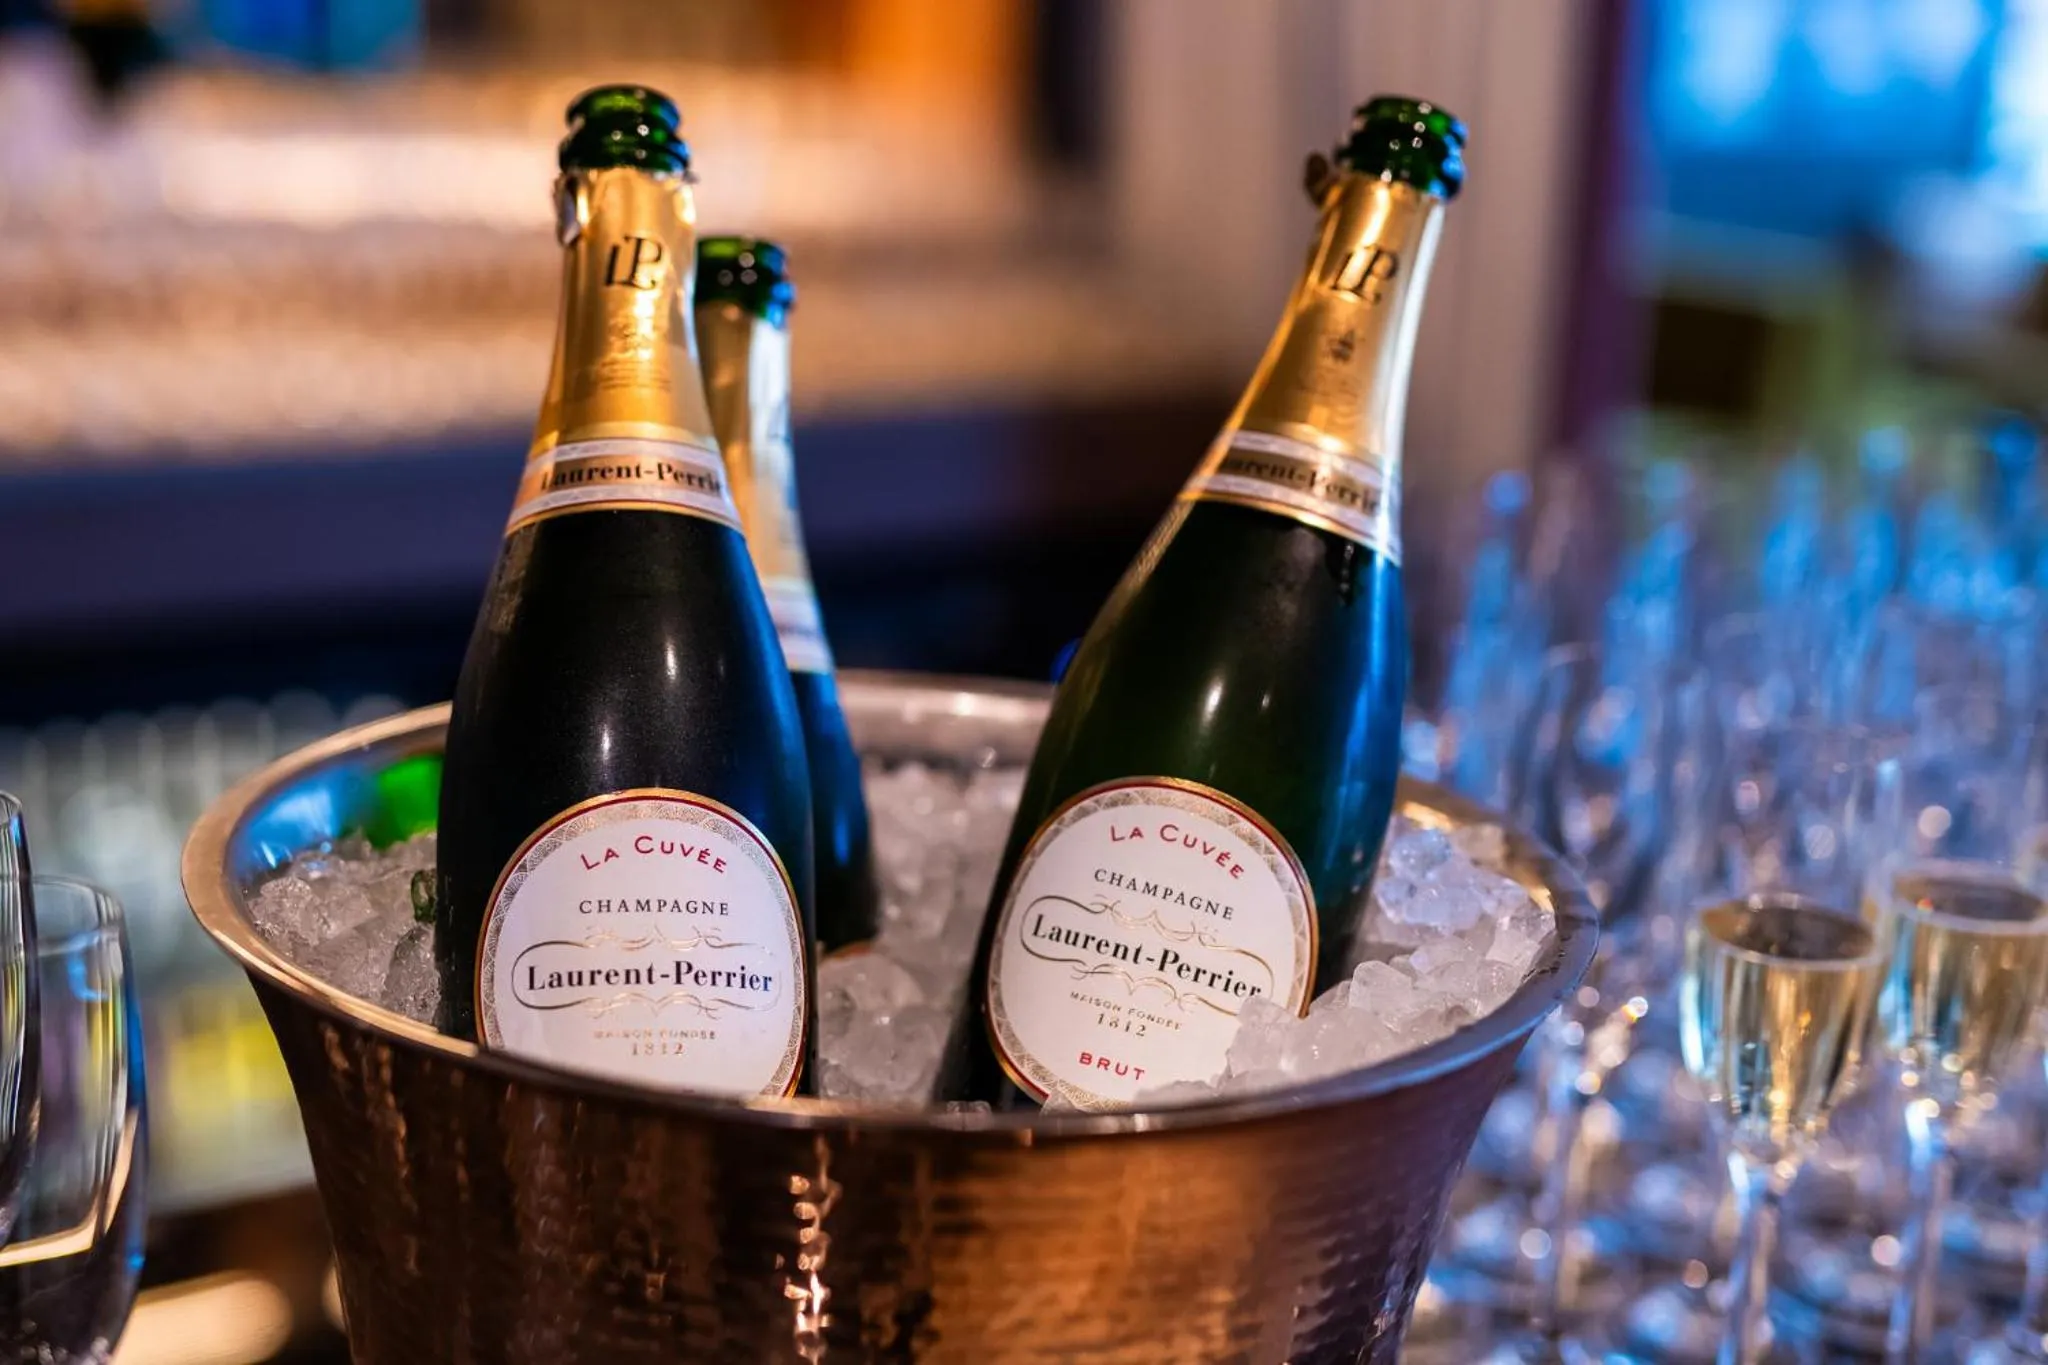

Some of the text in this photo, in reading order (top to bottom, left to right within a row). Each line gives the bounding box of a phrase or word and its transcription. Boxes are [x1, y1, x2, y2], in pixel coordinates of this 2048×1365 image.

[579, 899, 729, 916] CHAMPAGNE
[1094, 868, 1234, 921] CHAMPAGNE
[1032, 914, 1262, 1000] Laurent-Perrier
[528, 960, 773, 992] Laurent-Perrier
[632, 1042, 684, 1056] 1812
[1079, 1052, 1145, 1081] BRUT
